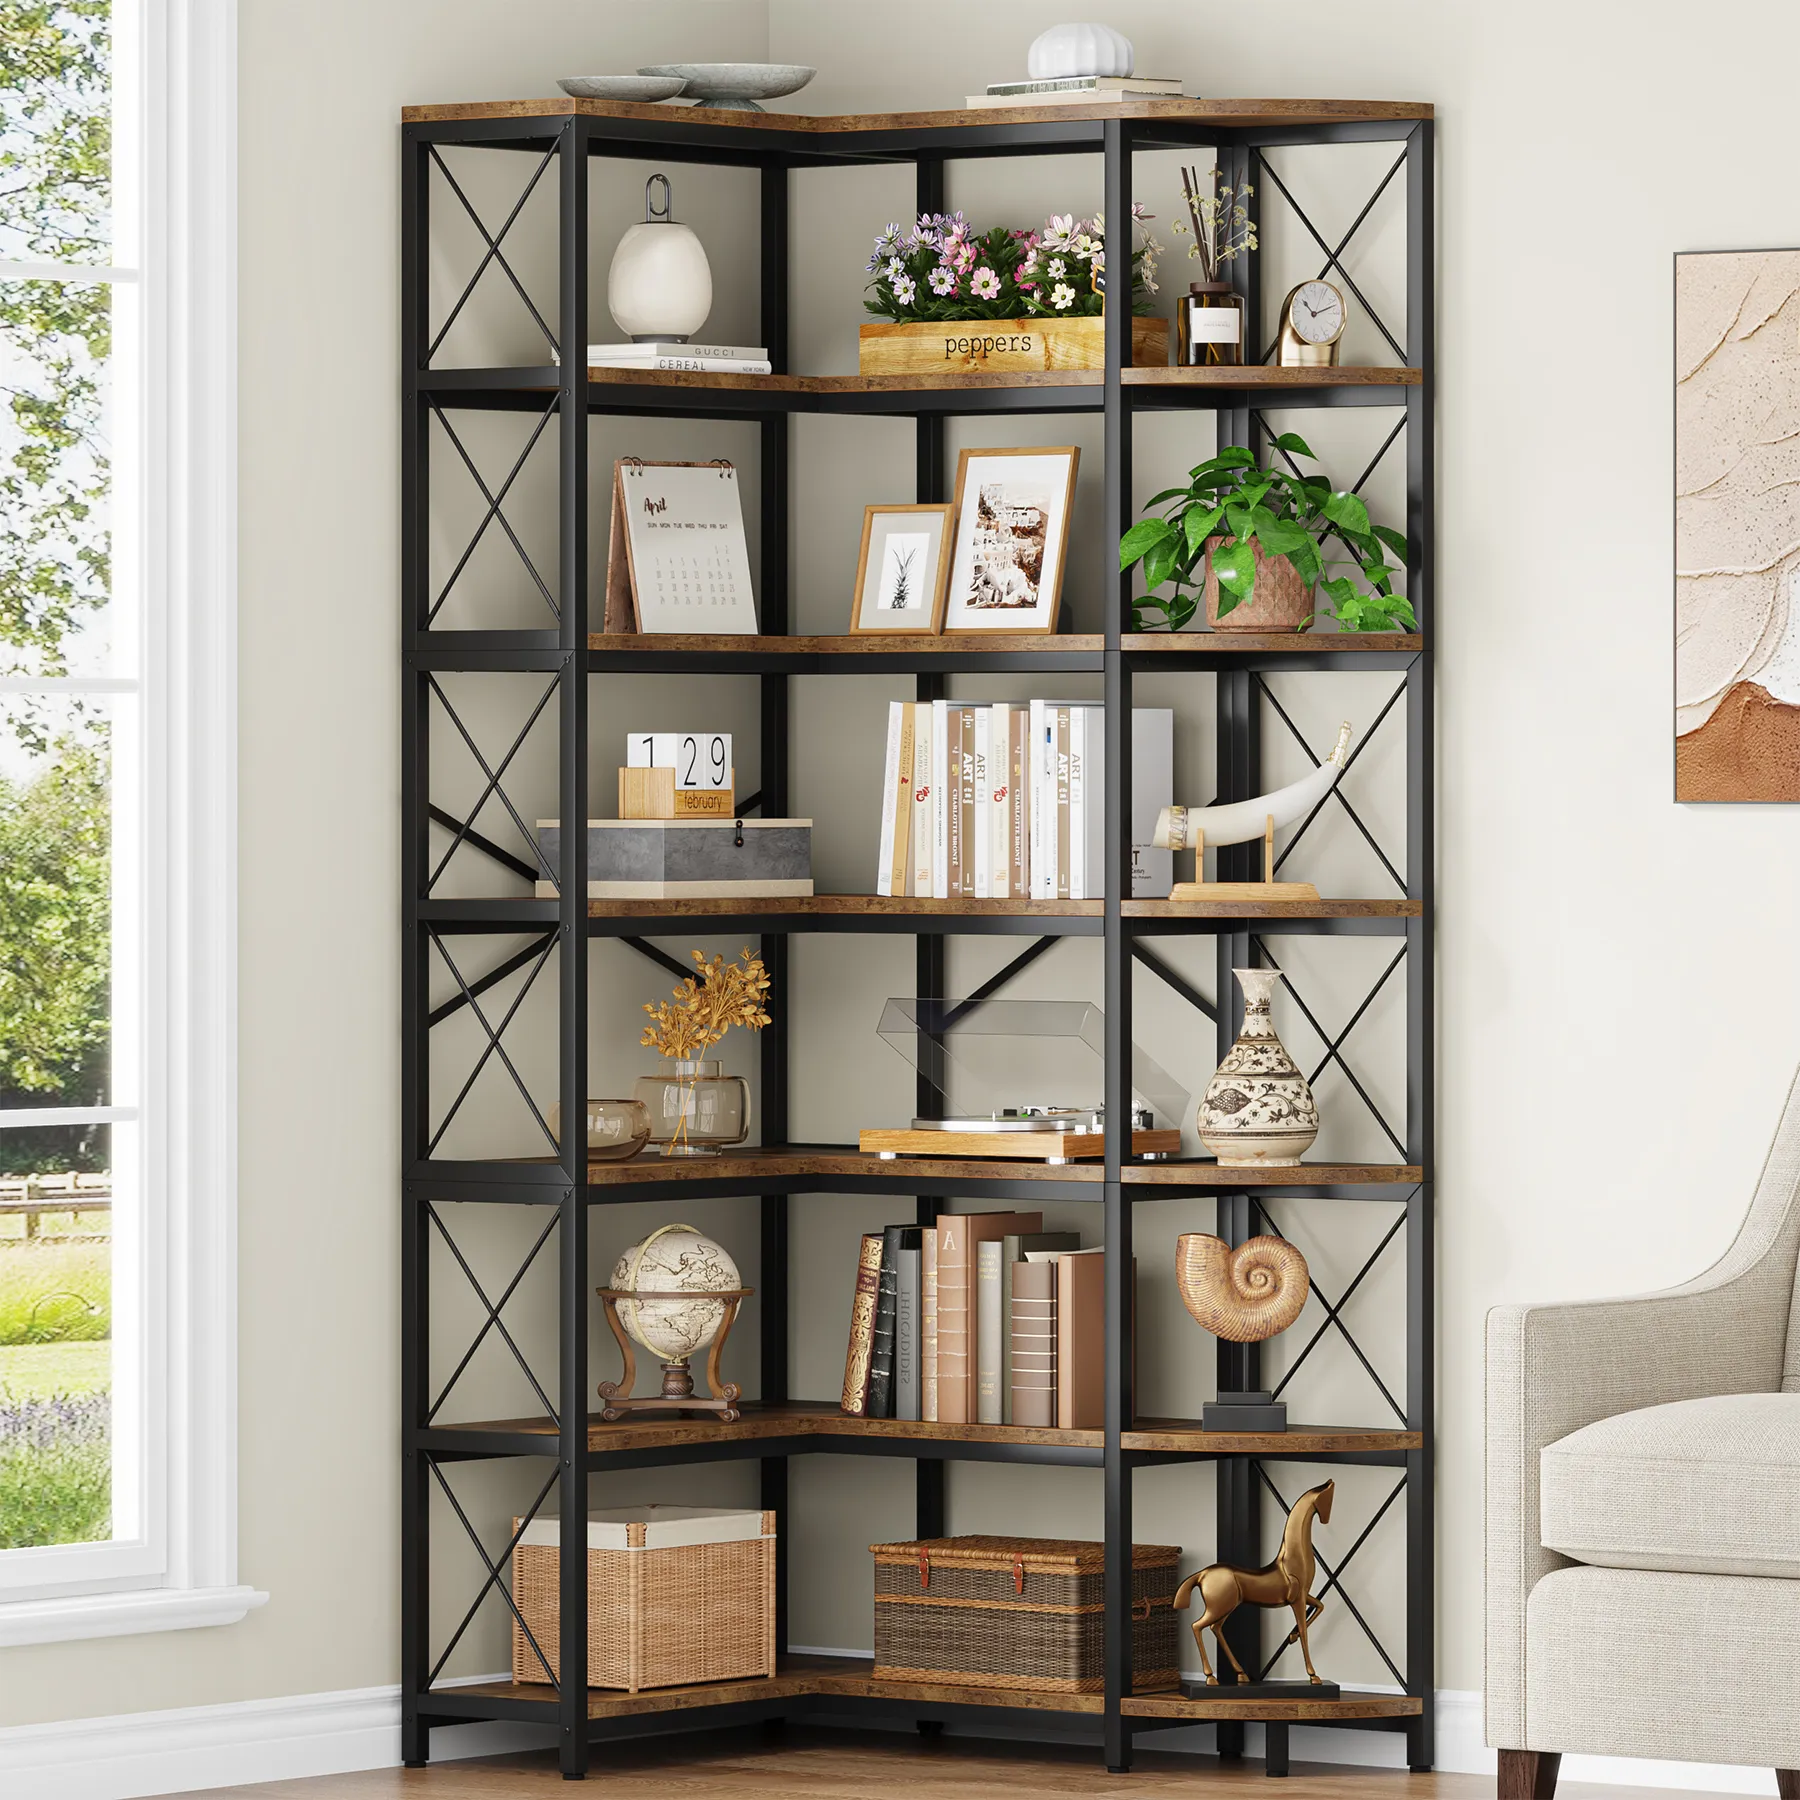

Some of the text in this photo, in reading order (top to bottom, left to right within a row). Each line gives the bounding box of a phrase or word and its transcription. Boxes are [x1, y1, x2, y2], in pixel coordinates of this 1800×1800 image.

[694, 347, 735, 357] GUCCI
[944, 335, 1032, 360] peppers
[659, 359, 707, 371] CEREAL
[644, 497, 667, 516] April
[642, 736, 653, 768] 1
[962, 752, 974, 783] ART
[976, 753, 986, 782] ART
[1058, 752, 1069, 783] ART
[1071, 753, 1081, 782] ART
[684, 790, 722, 813] february
[951, 788, 959, 834] CHARLOTTE
[942, 1230, 957, 1251] A
